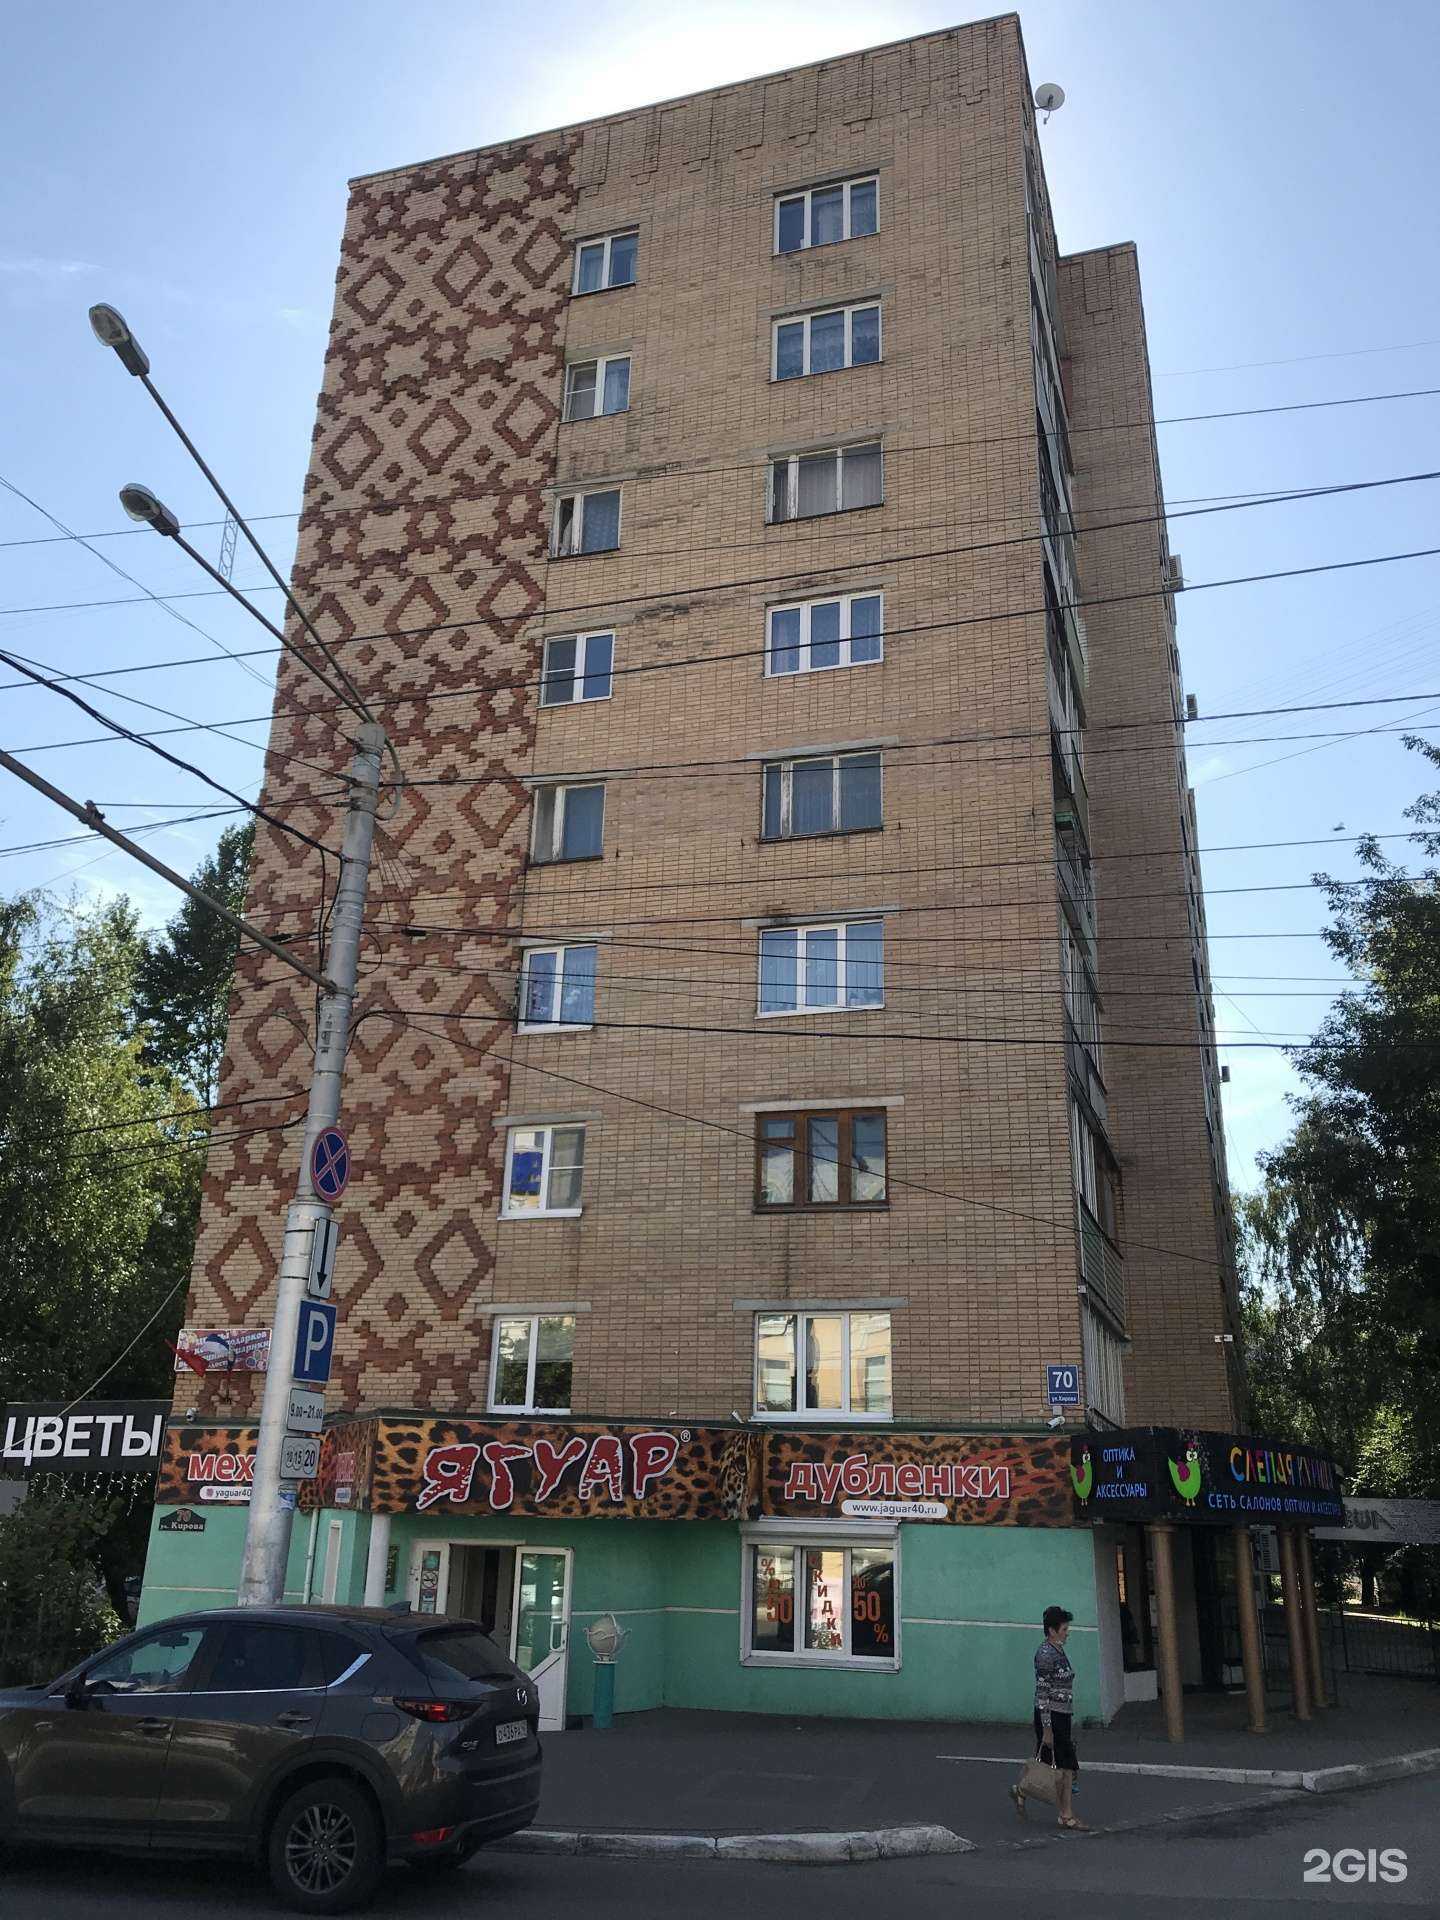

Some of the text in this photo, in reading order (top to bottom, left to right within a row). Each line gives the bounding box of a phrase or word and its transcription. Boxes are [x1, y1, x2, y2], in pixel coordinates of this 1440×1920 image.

[304, 1310, 328, 1372] P
[1052, 1371, 1073, 1388] 70
[3, 1415, 163, 1466] ЦВЕТЫ
[304, 1449, 316, 1467] 20
[1102, 1447, 1136, 1462] ОПТИКА
[416, 1432, 679, 1510] ЯГУАР
[784, 1453, 1010, 1505] дубленки
[1116, 1466, 1123, 1479] И
[1096, 1482, 1147, 1498] АКСЕССУАРЫ
[852, 1503, 938, 1515] www.jaguar40.ru
[1208, 1493, 1236, 1509] СЕТЬ
[1240, 1495, 1282, 1512] САЛОНОВ
[171, 1521, 204, 1531] Кирова
[853, 1590, 881, 1622] 50
